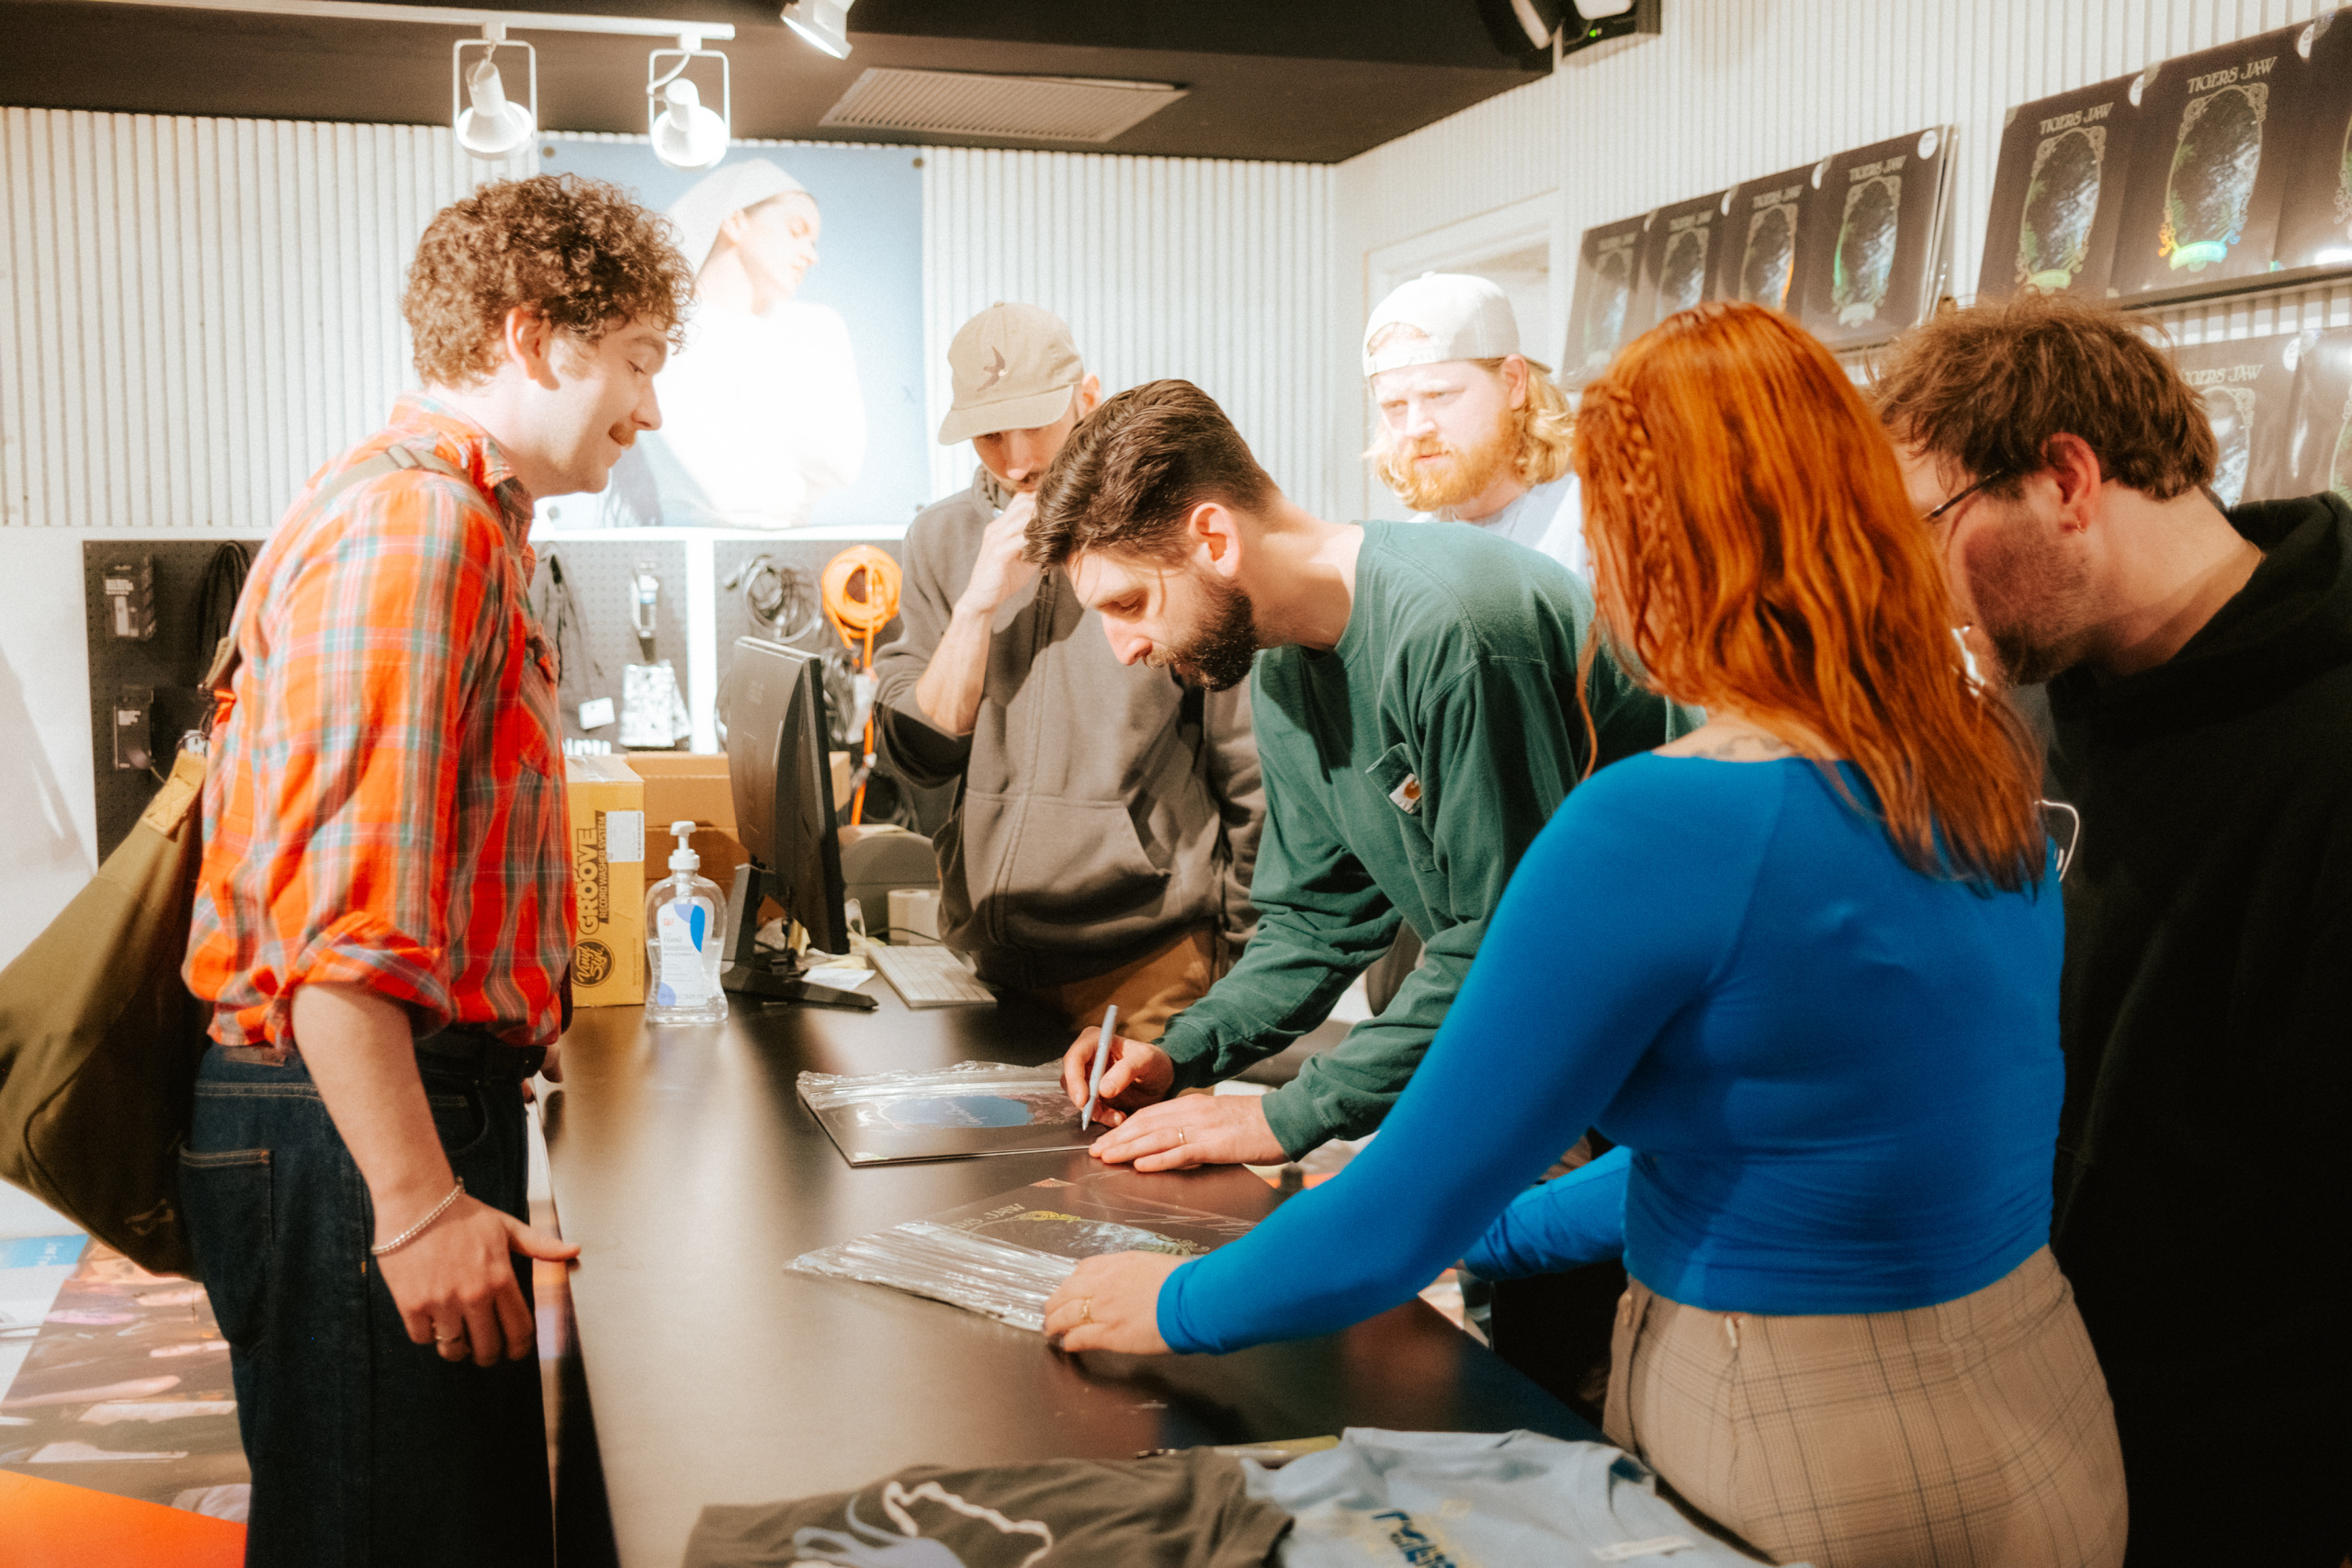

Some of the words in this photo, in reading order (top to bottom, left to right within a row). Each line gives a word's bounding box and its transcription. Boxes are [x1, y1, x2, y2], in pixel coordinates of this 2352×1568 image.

[2187, 65, 2239, 94] TIGERS
[2240, 55, 2278, 81] JAW
[2040, 110, 2083, 135] TIGERS
[2083, 101, 2115, 124] JAW
[2227, 363, 2265, 383] JAW
[597, 816, 606, 849] SYSTEM
[576, 828, 599, 935] GROOVE
[598, 850, 607, 886] WASHER
[599, 886, 608, 919] RECORD
[575, 945, 594, 983] Vinyl
[982, 1202, 1025, 1220] JAW
